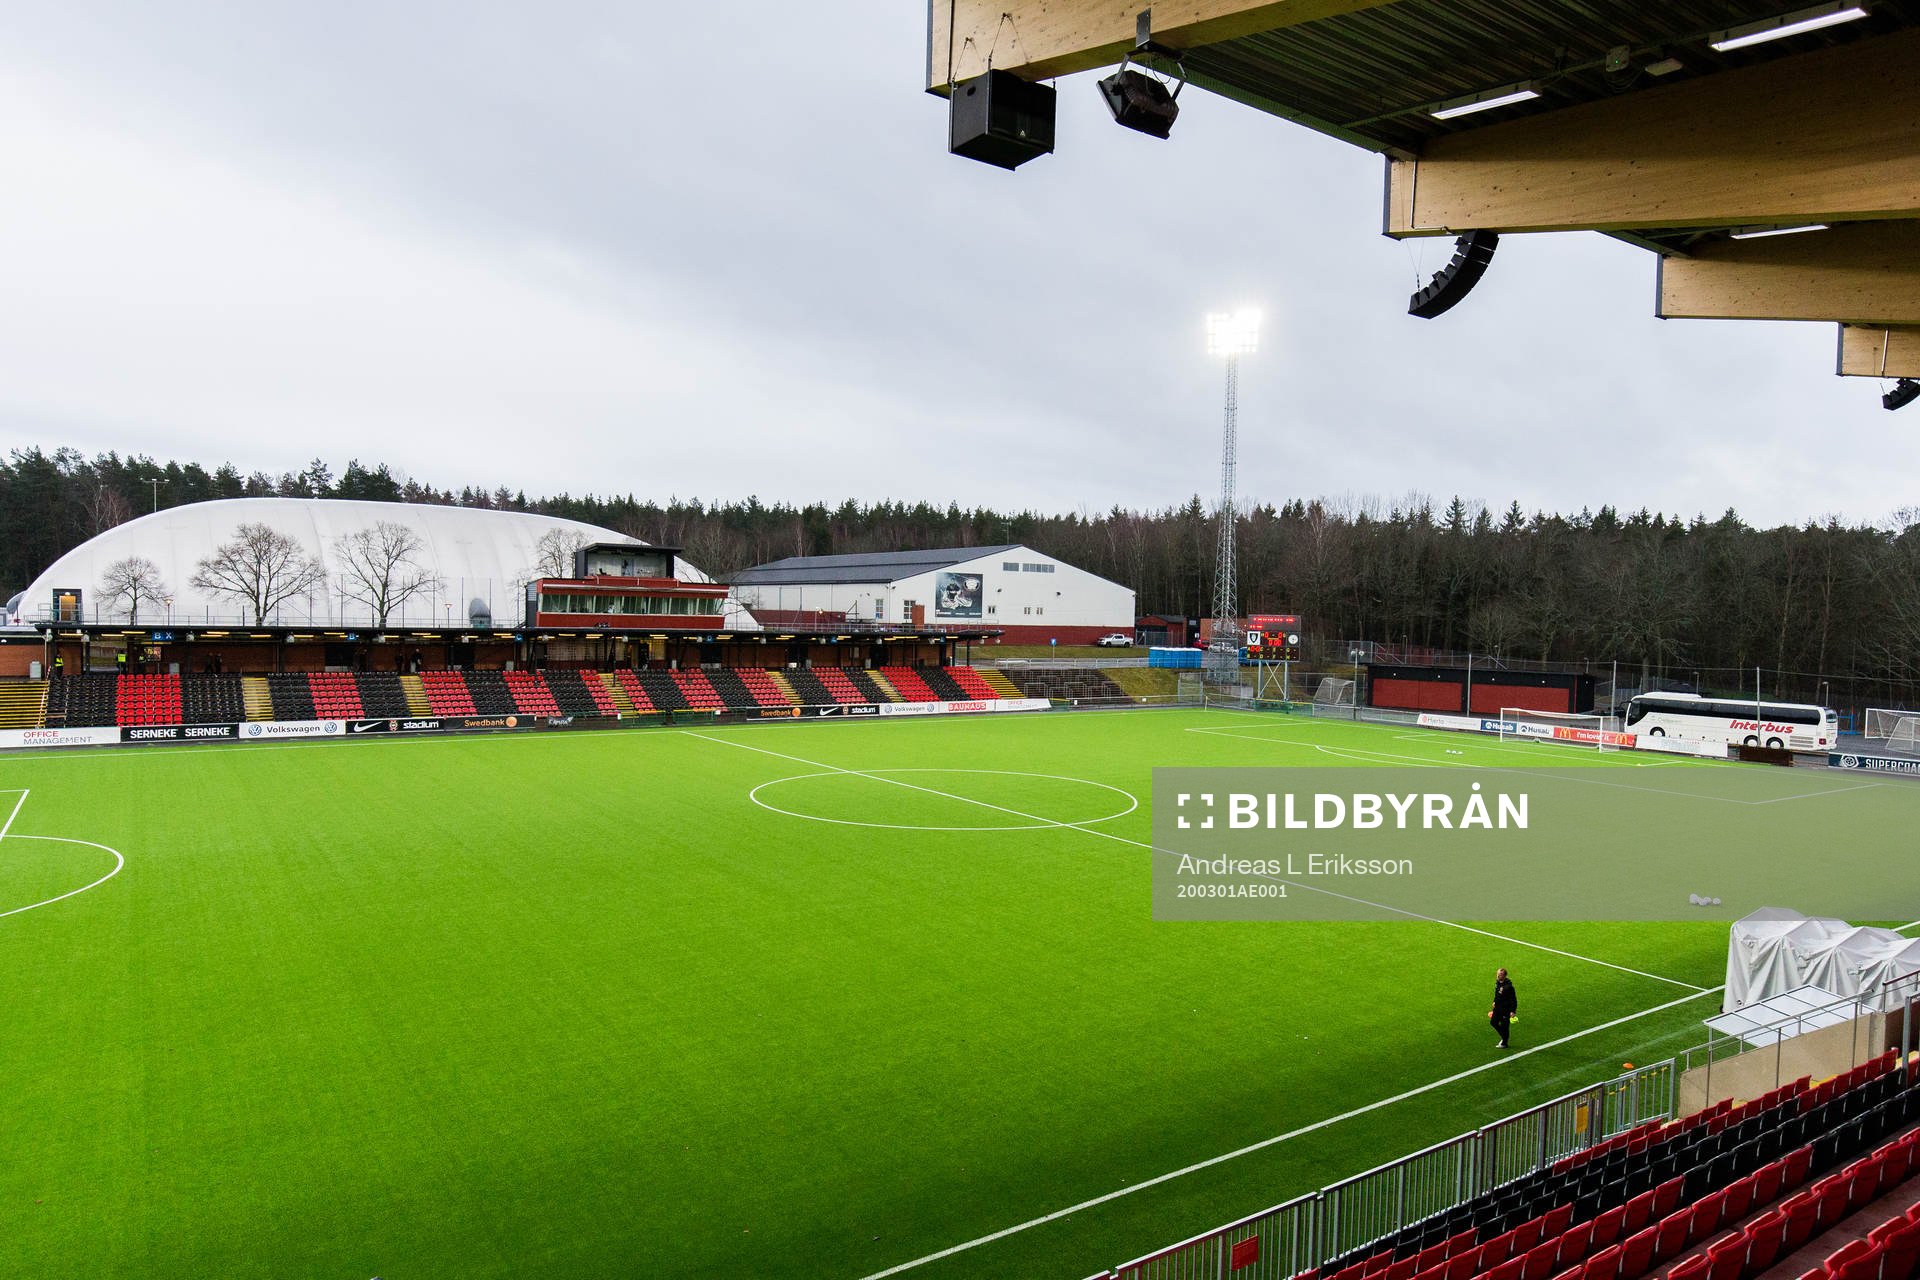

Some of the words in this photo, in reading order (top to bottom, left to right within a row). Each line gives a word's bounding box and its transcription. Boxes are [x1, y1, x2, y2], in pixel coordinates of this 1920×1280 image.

[851, 706, 876, 714] stadium
[948, 702, 986, 711] BAUHAUS
[760, 709, 791, 717] Swedbank
[403, 719, 439, 729] stadium
[464, 718, 505, 727] Swedbank
[1729, 719, 1794, 734] Interbus
[130, 728, 177, 739] SERNEKE
[185, 727, 230, 737] SERNEKE
[266, 724, 321, 734] Volkswagen
[23, 730, 59, 739] OFFICE
[23, 736, 92, 745] MANAGEMENT
